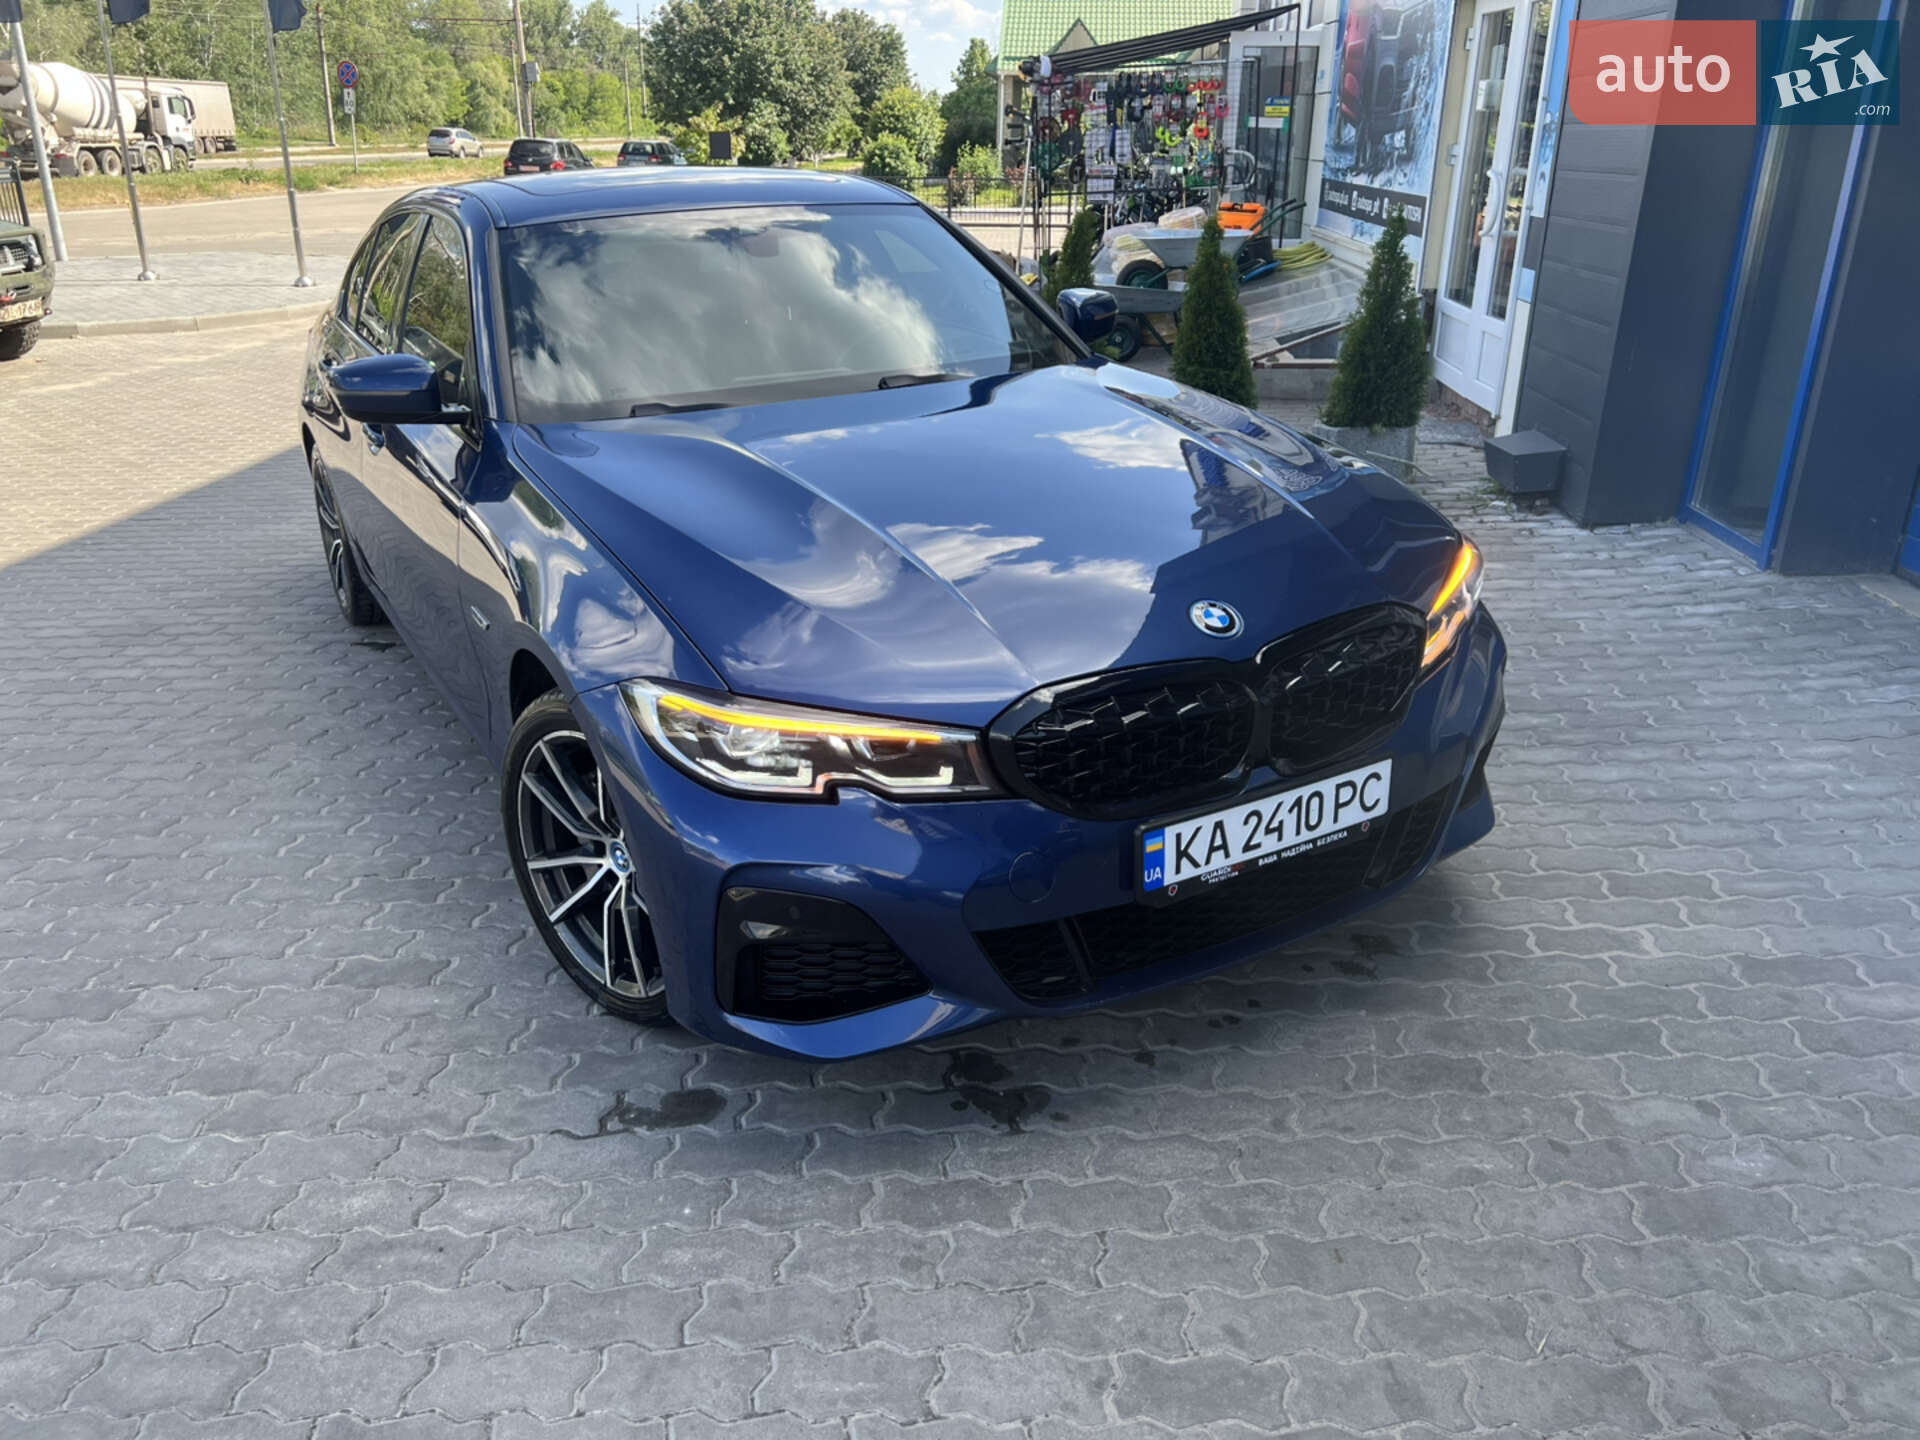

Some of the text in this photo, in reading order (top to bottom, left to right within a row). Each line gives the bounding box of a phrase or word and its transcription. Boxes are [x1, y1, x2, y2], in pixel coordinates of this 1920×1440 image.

[1174, 771, 1383, 876] KA 2410 PC
[1258, 854, 1278, 866] ВАША
[1317, 830, 1348, 846] БЕЗПЕКА
[1144, 866, 1163, 883] UA
